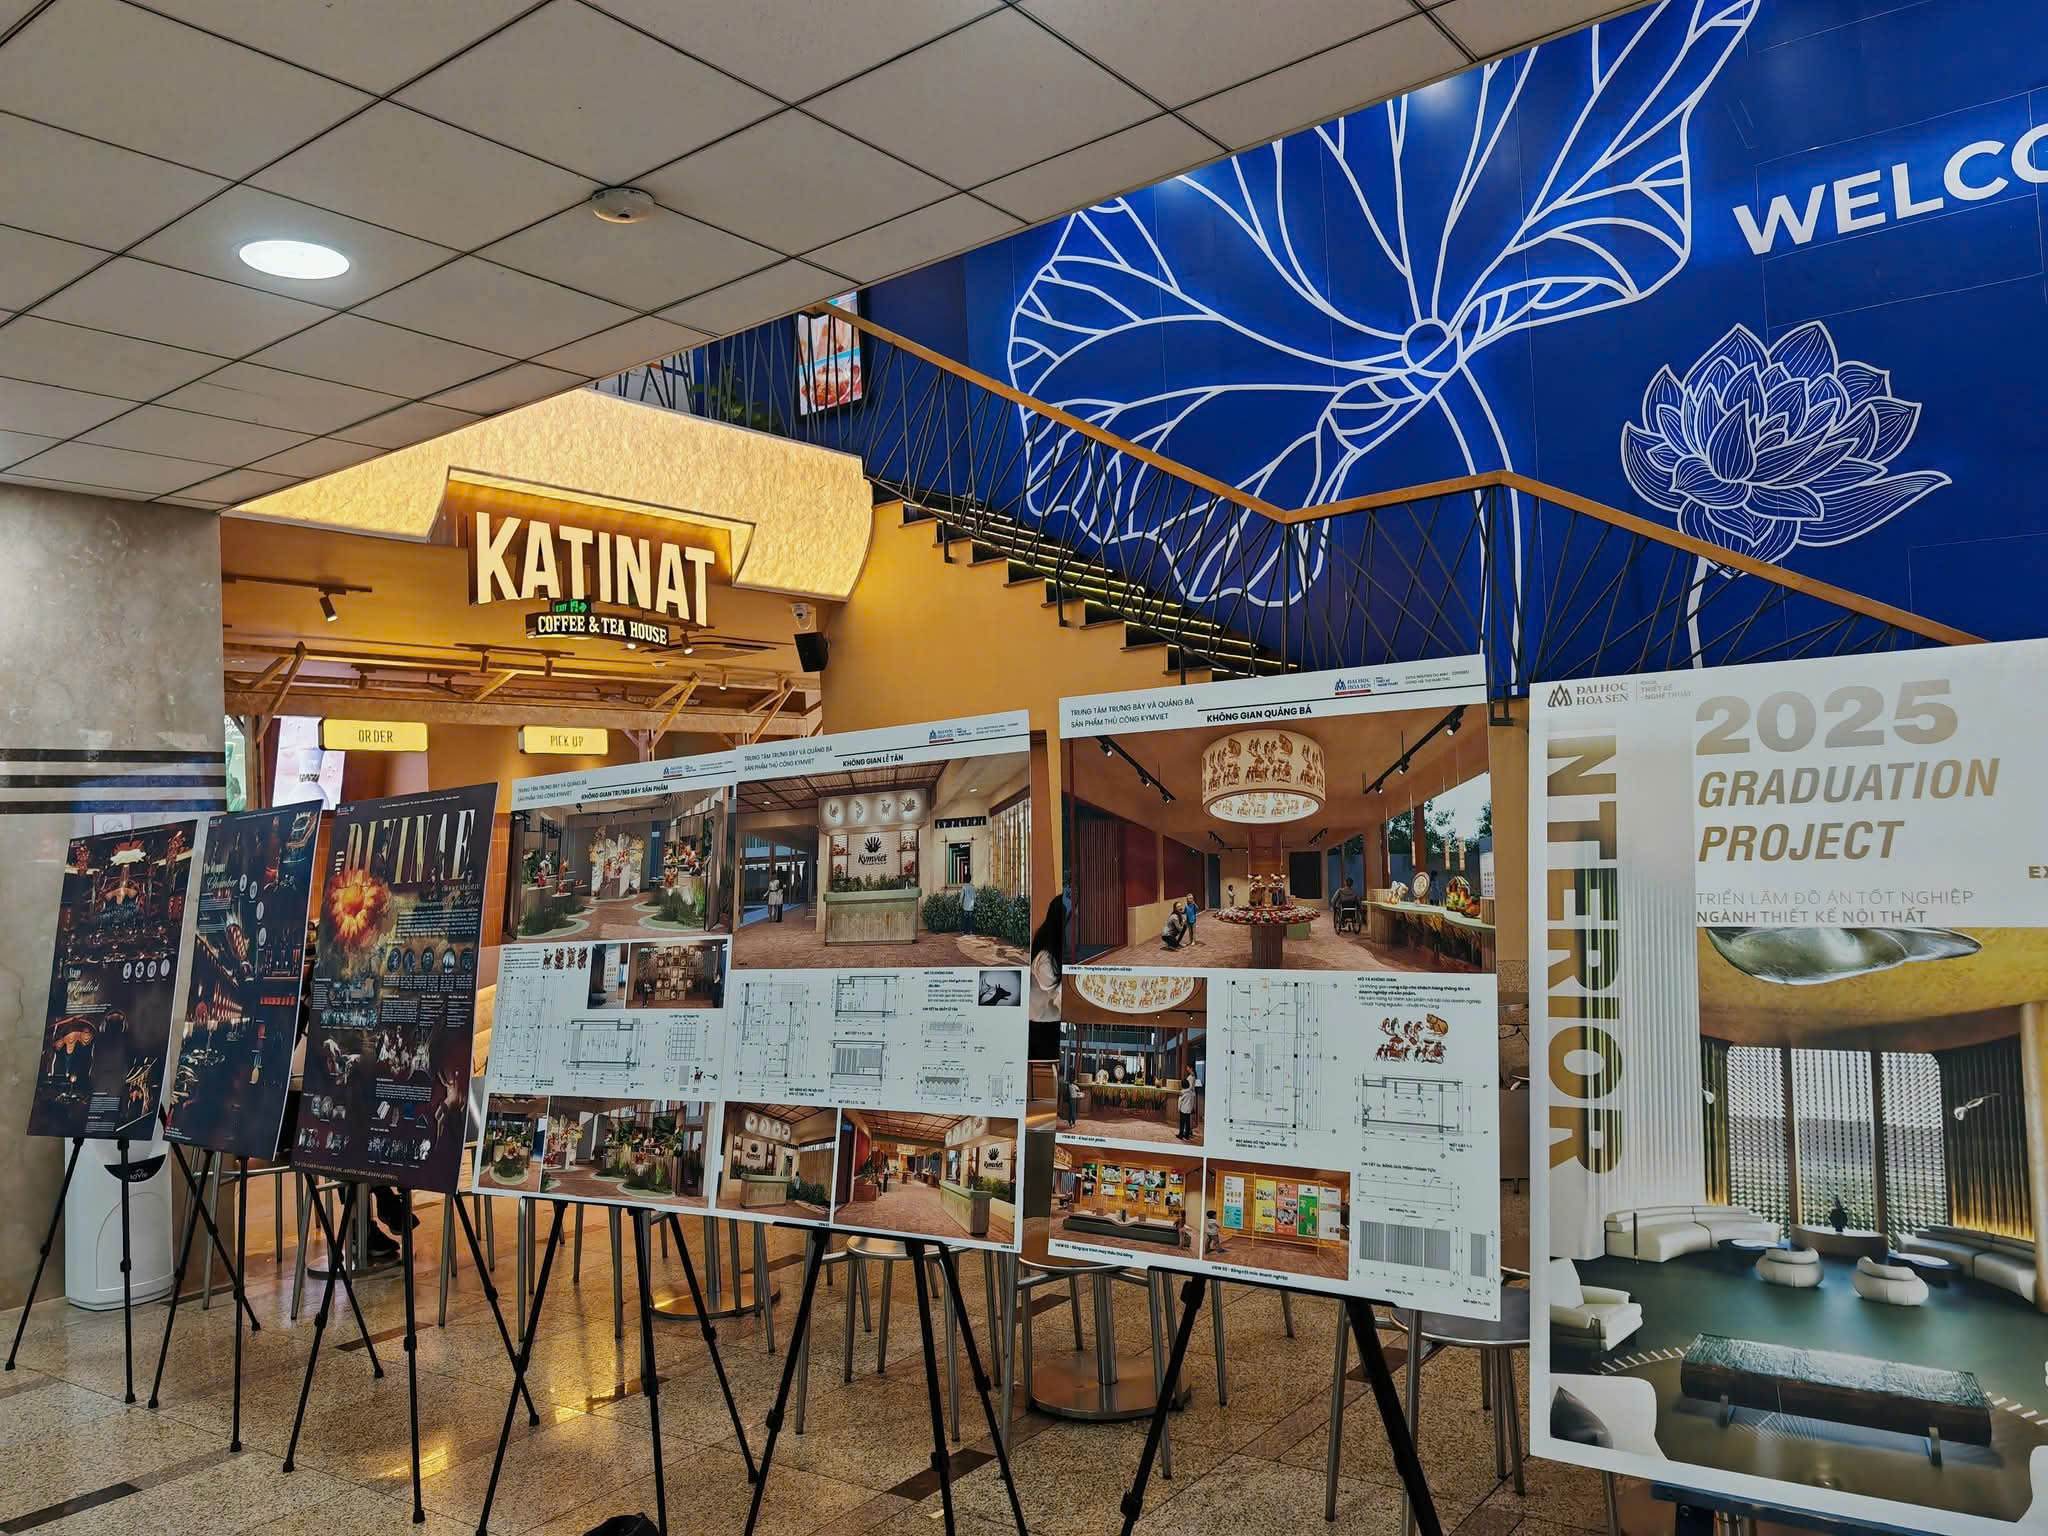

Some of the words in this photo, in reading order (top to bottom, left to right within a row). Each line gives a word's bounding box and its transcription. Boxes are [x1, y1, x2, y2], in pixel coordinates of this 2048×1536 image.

[475, 511, 715, 627] KATINAT
[537, 615, 585, 633] COFFEE
[589, 616, 600, 632] &
[601, 618, 626, 636] TEA
[629, 621, 667, 646] HOUSE
[1576, 695, 1603, 706] HOA
[1605, 693, 1629, 704] SEN
[1206, 711, 1239, 723] KHÔNG
[1240, 711, 1263, 720] GIAN
[1264, 706, 1297, 719] QUẢNG
[1299, 703, 1312, 715] BÁ
[1696, 679, 1958, 756] 2025
[358, 728, 394, 744] ORDER
[550, 736, 569, 747] PICK
[572, 737, 584, 747] UP
[842, 757, 866, 768] KHÔNG
[867, 757, 882, 766] GIAN
[1698, 757, 2000, 808] GRADUATION
[581, 788, 599, 800] KHÔNG
[599, 788, 612, 799] GIAN
[1698, 819, 1905, 863] PROJECT
[1697, 907, 1756, 923] NGÀNH
[1760, 906, 1808, 923] THIẾT
[1842, 907, 1874, 926] NỘI
[1880, 906, 1927, 923] THẤT
